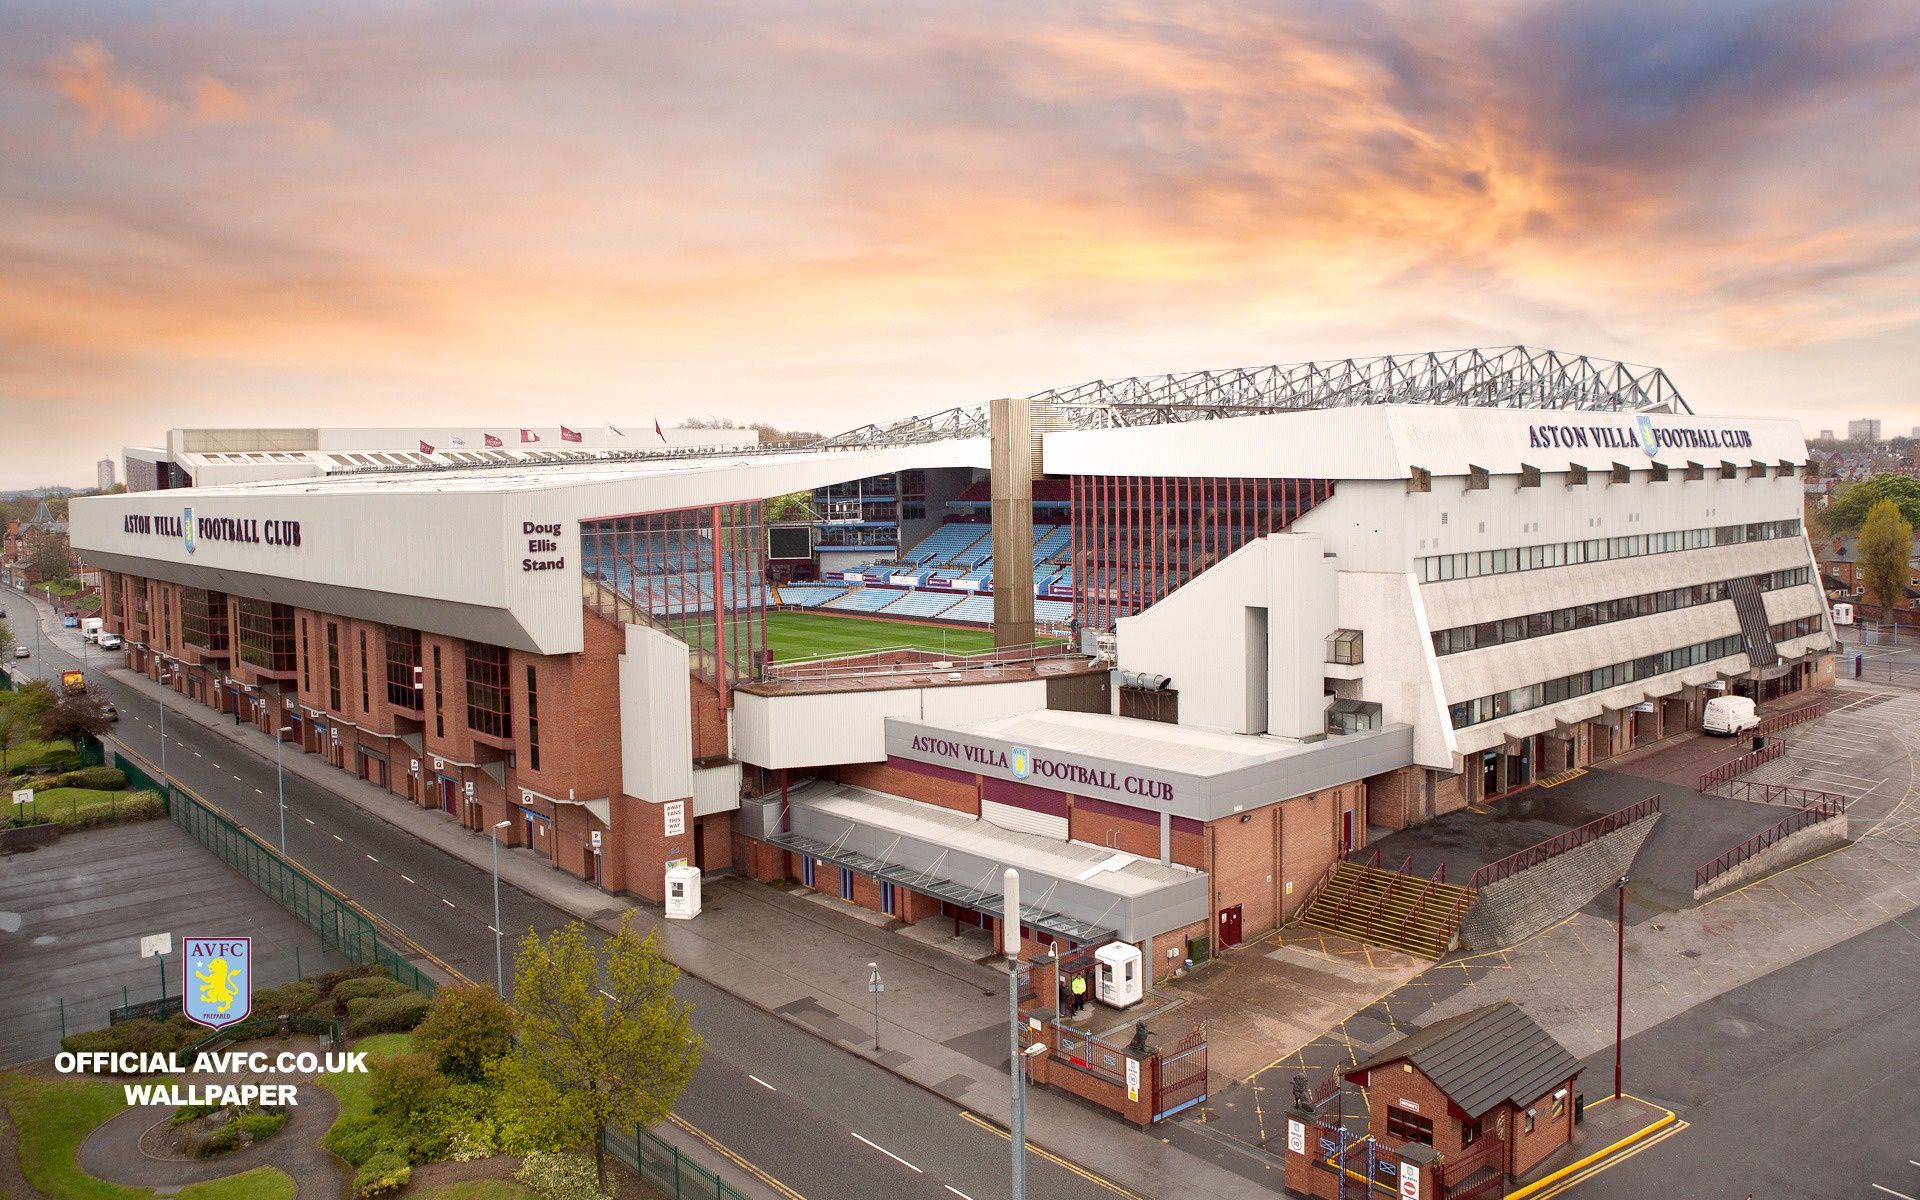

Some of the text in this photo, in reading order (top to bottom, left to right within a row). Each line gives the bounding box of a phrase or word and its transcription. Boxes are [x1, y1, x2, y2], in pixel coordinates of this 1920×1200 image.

[1529, 425, 1752, 448] ASTON VILLA FOOTBALL CLUB
[124, 515, 301, 547] ASTON VILLA FOOTBALL CLUB
[523, 521, 561, 536] Doug
[528, 539, 557, 552] Ellis
[522, 557, 564, 571] Stand
[911, 735, 1174, 800] ASTON VILLA FOOTBALL CLUB
